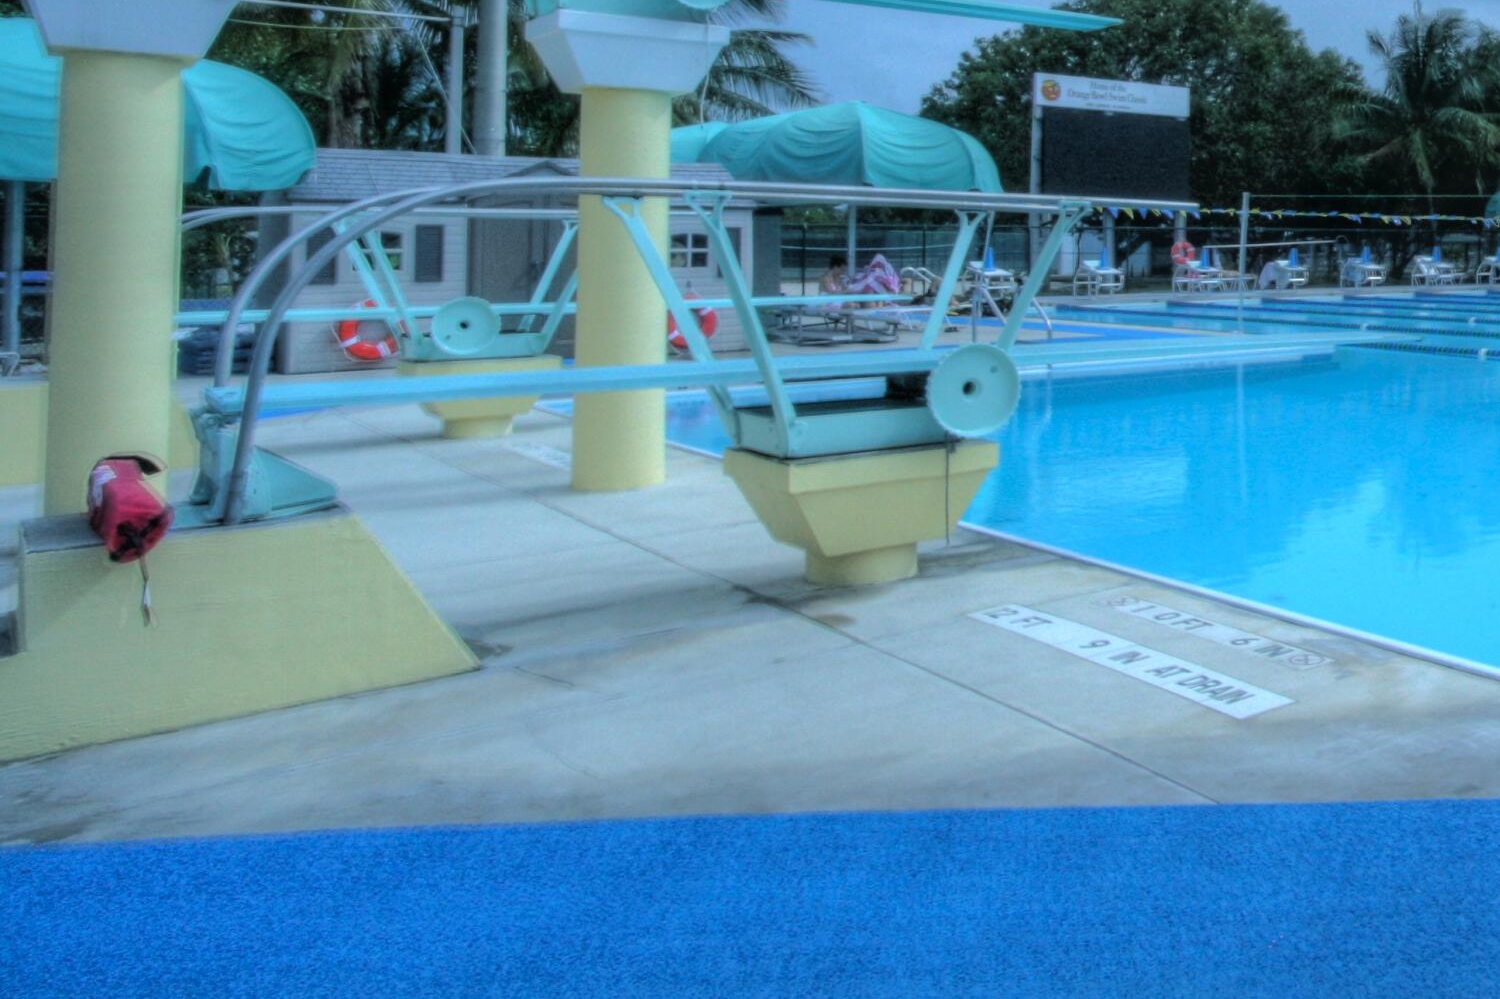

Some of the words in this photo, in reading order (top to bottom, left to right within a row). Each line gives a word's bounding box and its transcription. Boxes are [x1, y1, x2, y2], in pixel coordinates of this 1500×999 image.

[1010, 616, 1053, 628] FT
[1079, 639, 1111, 649] 9
[1108, 651, 1151, 664] IN
[1144, 665, 1192, 678] AT
[1176, 675, 1256, 704] DRAIN
[1170, 618, 1214, 630] FT
[1253, 644, 1296, 657] IN
